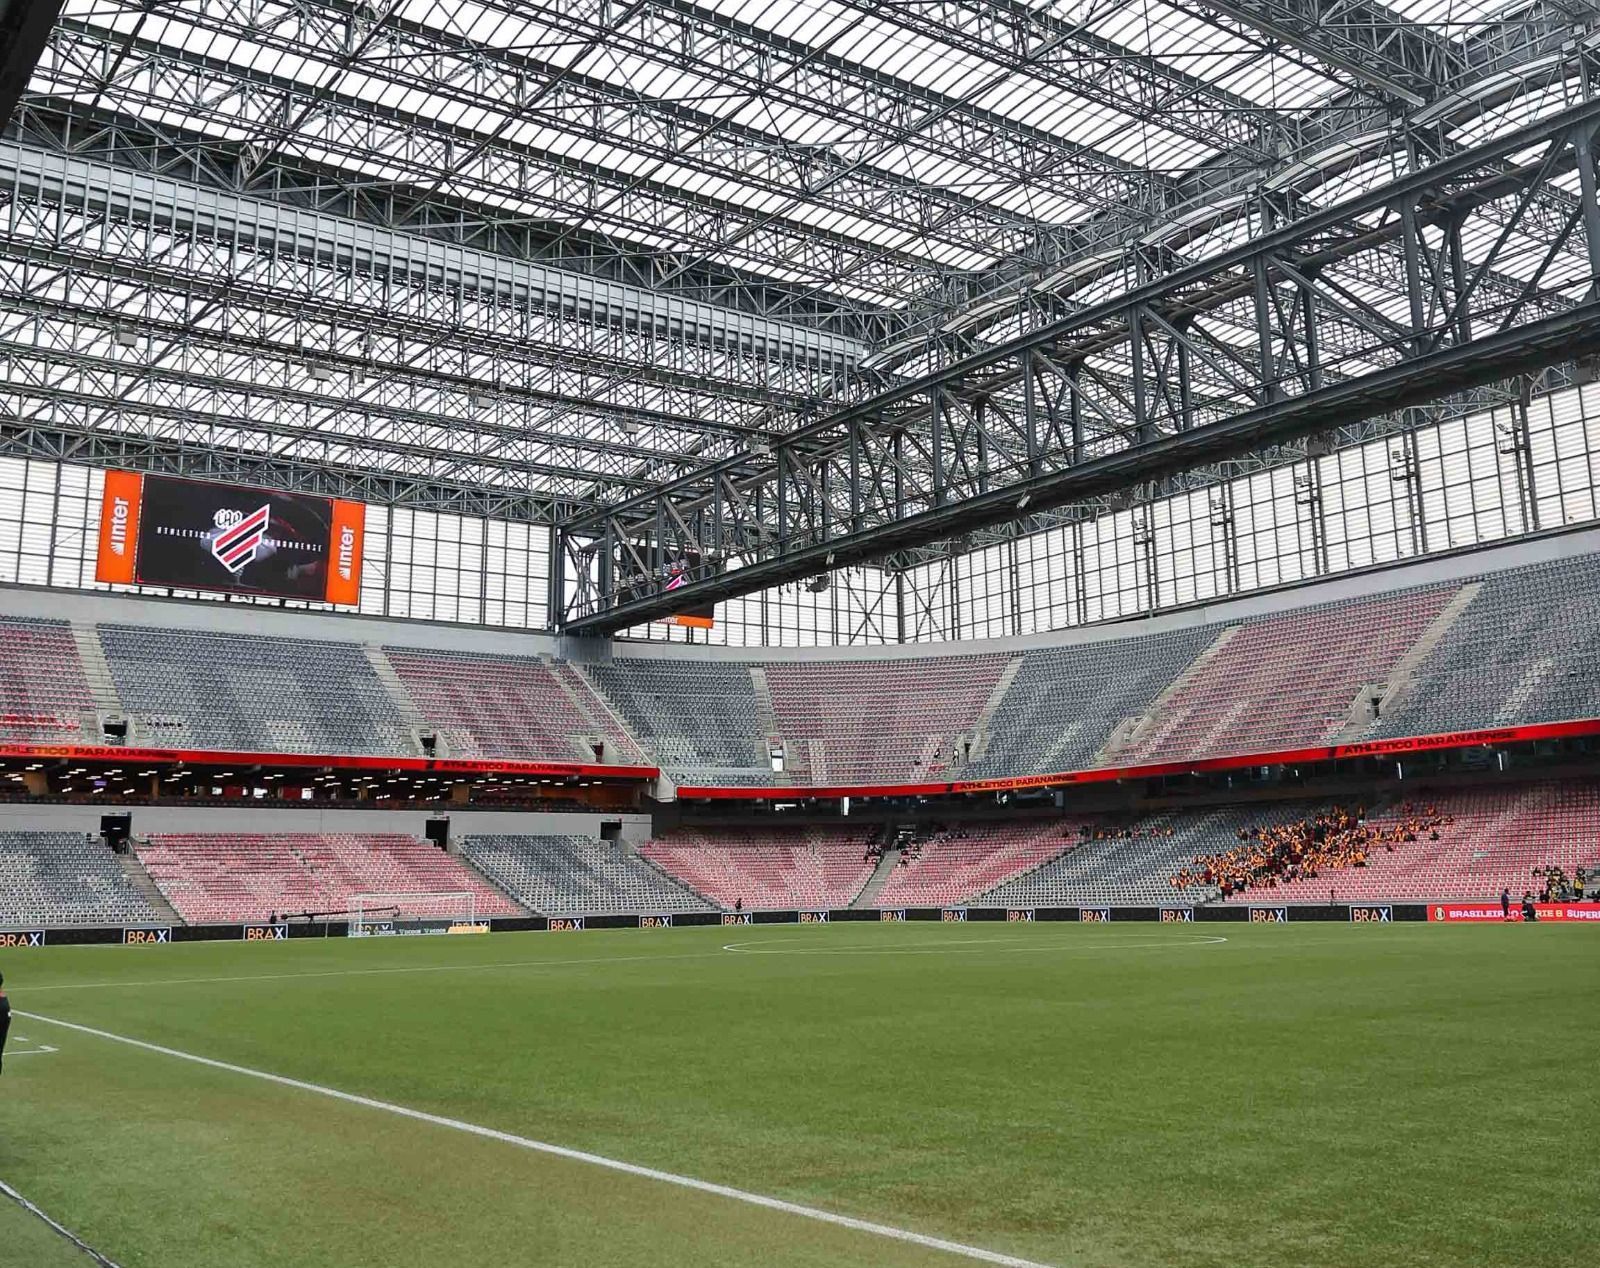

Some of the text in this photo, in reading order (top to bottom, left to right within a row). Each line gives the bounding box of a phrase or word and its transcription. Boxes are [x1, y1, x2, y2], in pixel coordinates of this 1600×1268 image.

[1343, 731, 1516, 754] ATHLETICO PARANAENSE
[724, 914, 750, 926] BRAX
[800, 912, 826, 923] BRAX
[882, 911, 903, 922] BRAX
[944, 911, 965, 922] BRAX
[1009, 910, 1032, 922] BRAX
[1082, 910, 1107, 922] BRAX
[1162, 910, 1191, 922] BRAX
[1251, 910, 1284, 922] BRAX
[1353, 908, 1389, 922] BRAX
[1449, 910, 1519, 919] BRASILEIRO
[550, 919, 581, 931] BRAX
[642, 917, 669, 928] BRAX
[127, 929, 168, 944] BRAX
[247, 927, 284, 940] BRAX
